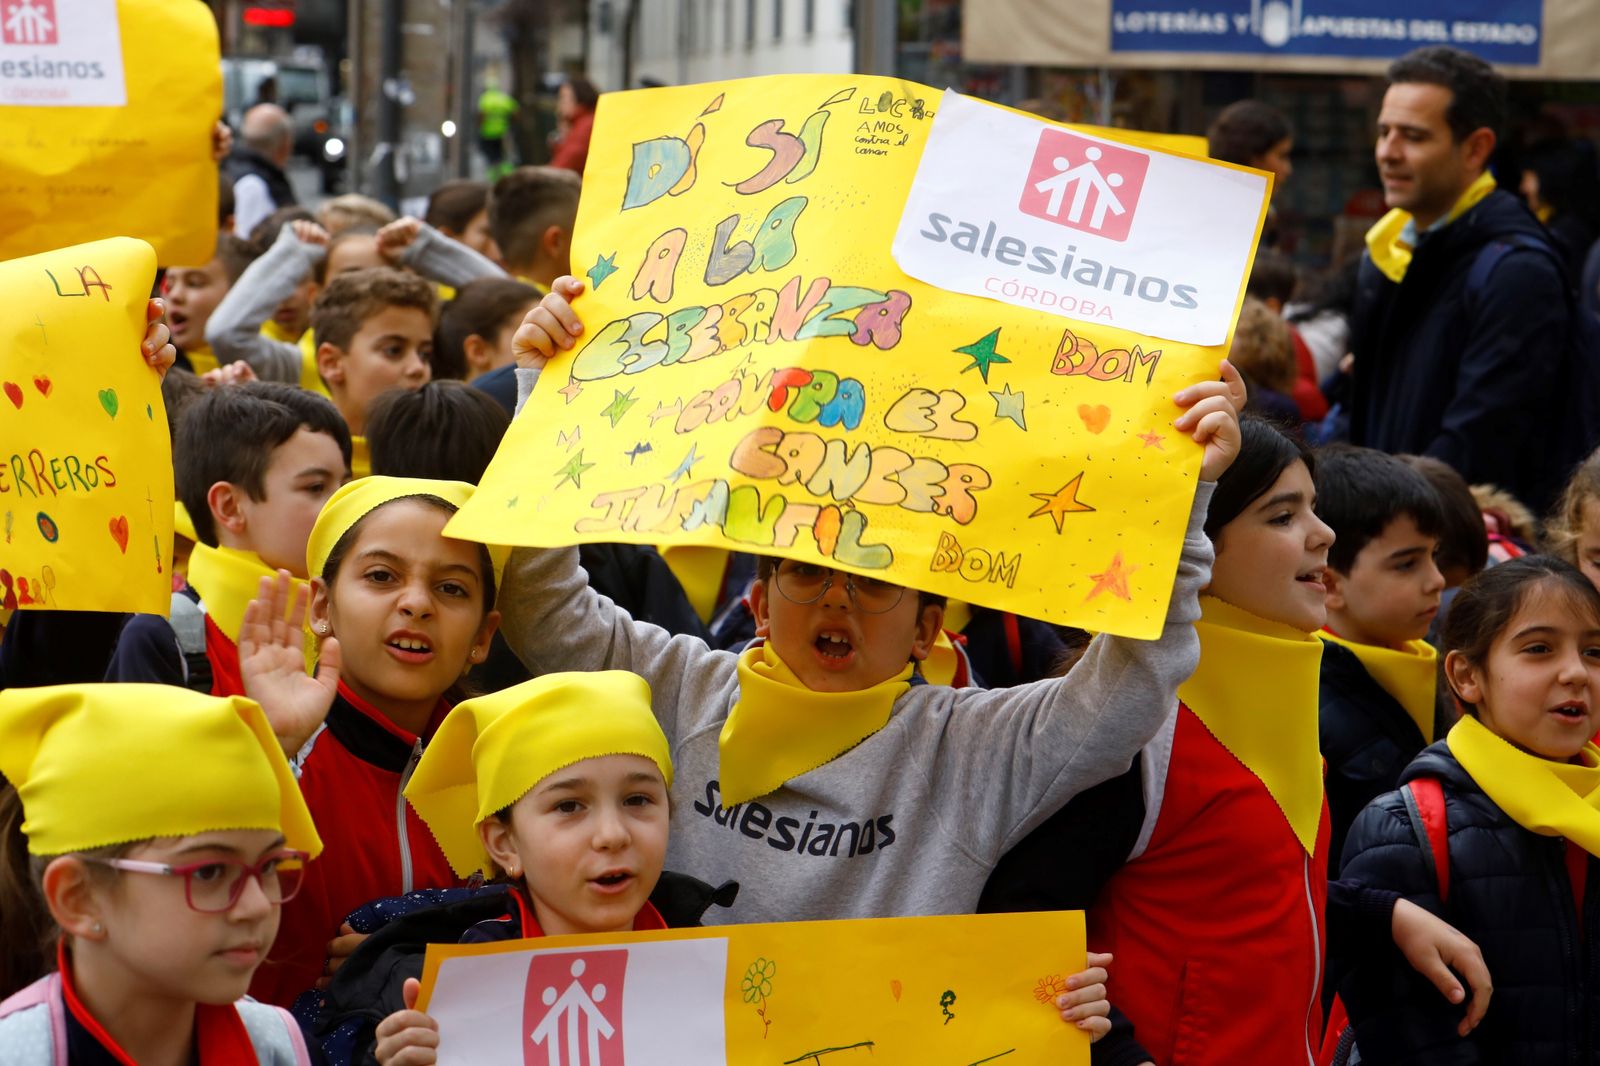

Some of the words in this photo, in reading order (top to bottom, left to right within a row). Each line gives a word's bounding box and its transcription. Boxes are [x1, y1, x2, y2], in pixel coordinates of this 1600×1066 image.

[1113, 8, 1228, 35] LOTERÍAS
[1233, 13, 1249, 35] Y
[1302, 15, 1407, 40] APUESTAS
[1408, 19, 1448, 41] DEL
[1452, 21, 1538, 45] ESTADO
[45, 264, 112, 302] LA
[627, 227, 688, 304] A
[703, 196, 808, 287] LA
[919, 211, 1200, 311] salesianos
[984, 276, 1115, 321] CÓRDOBA
[674, 366, 866, 434] CONTRA
[884, 387, 979, 442] EL
[729, 426, 992, 526] CANCER
[574, 478, 894, 570] INFANTIL
